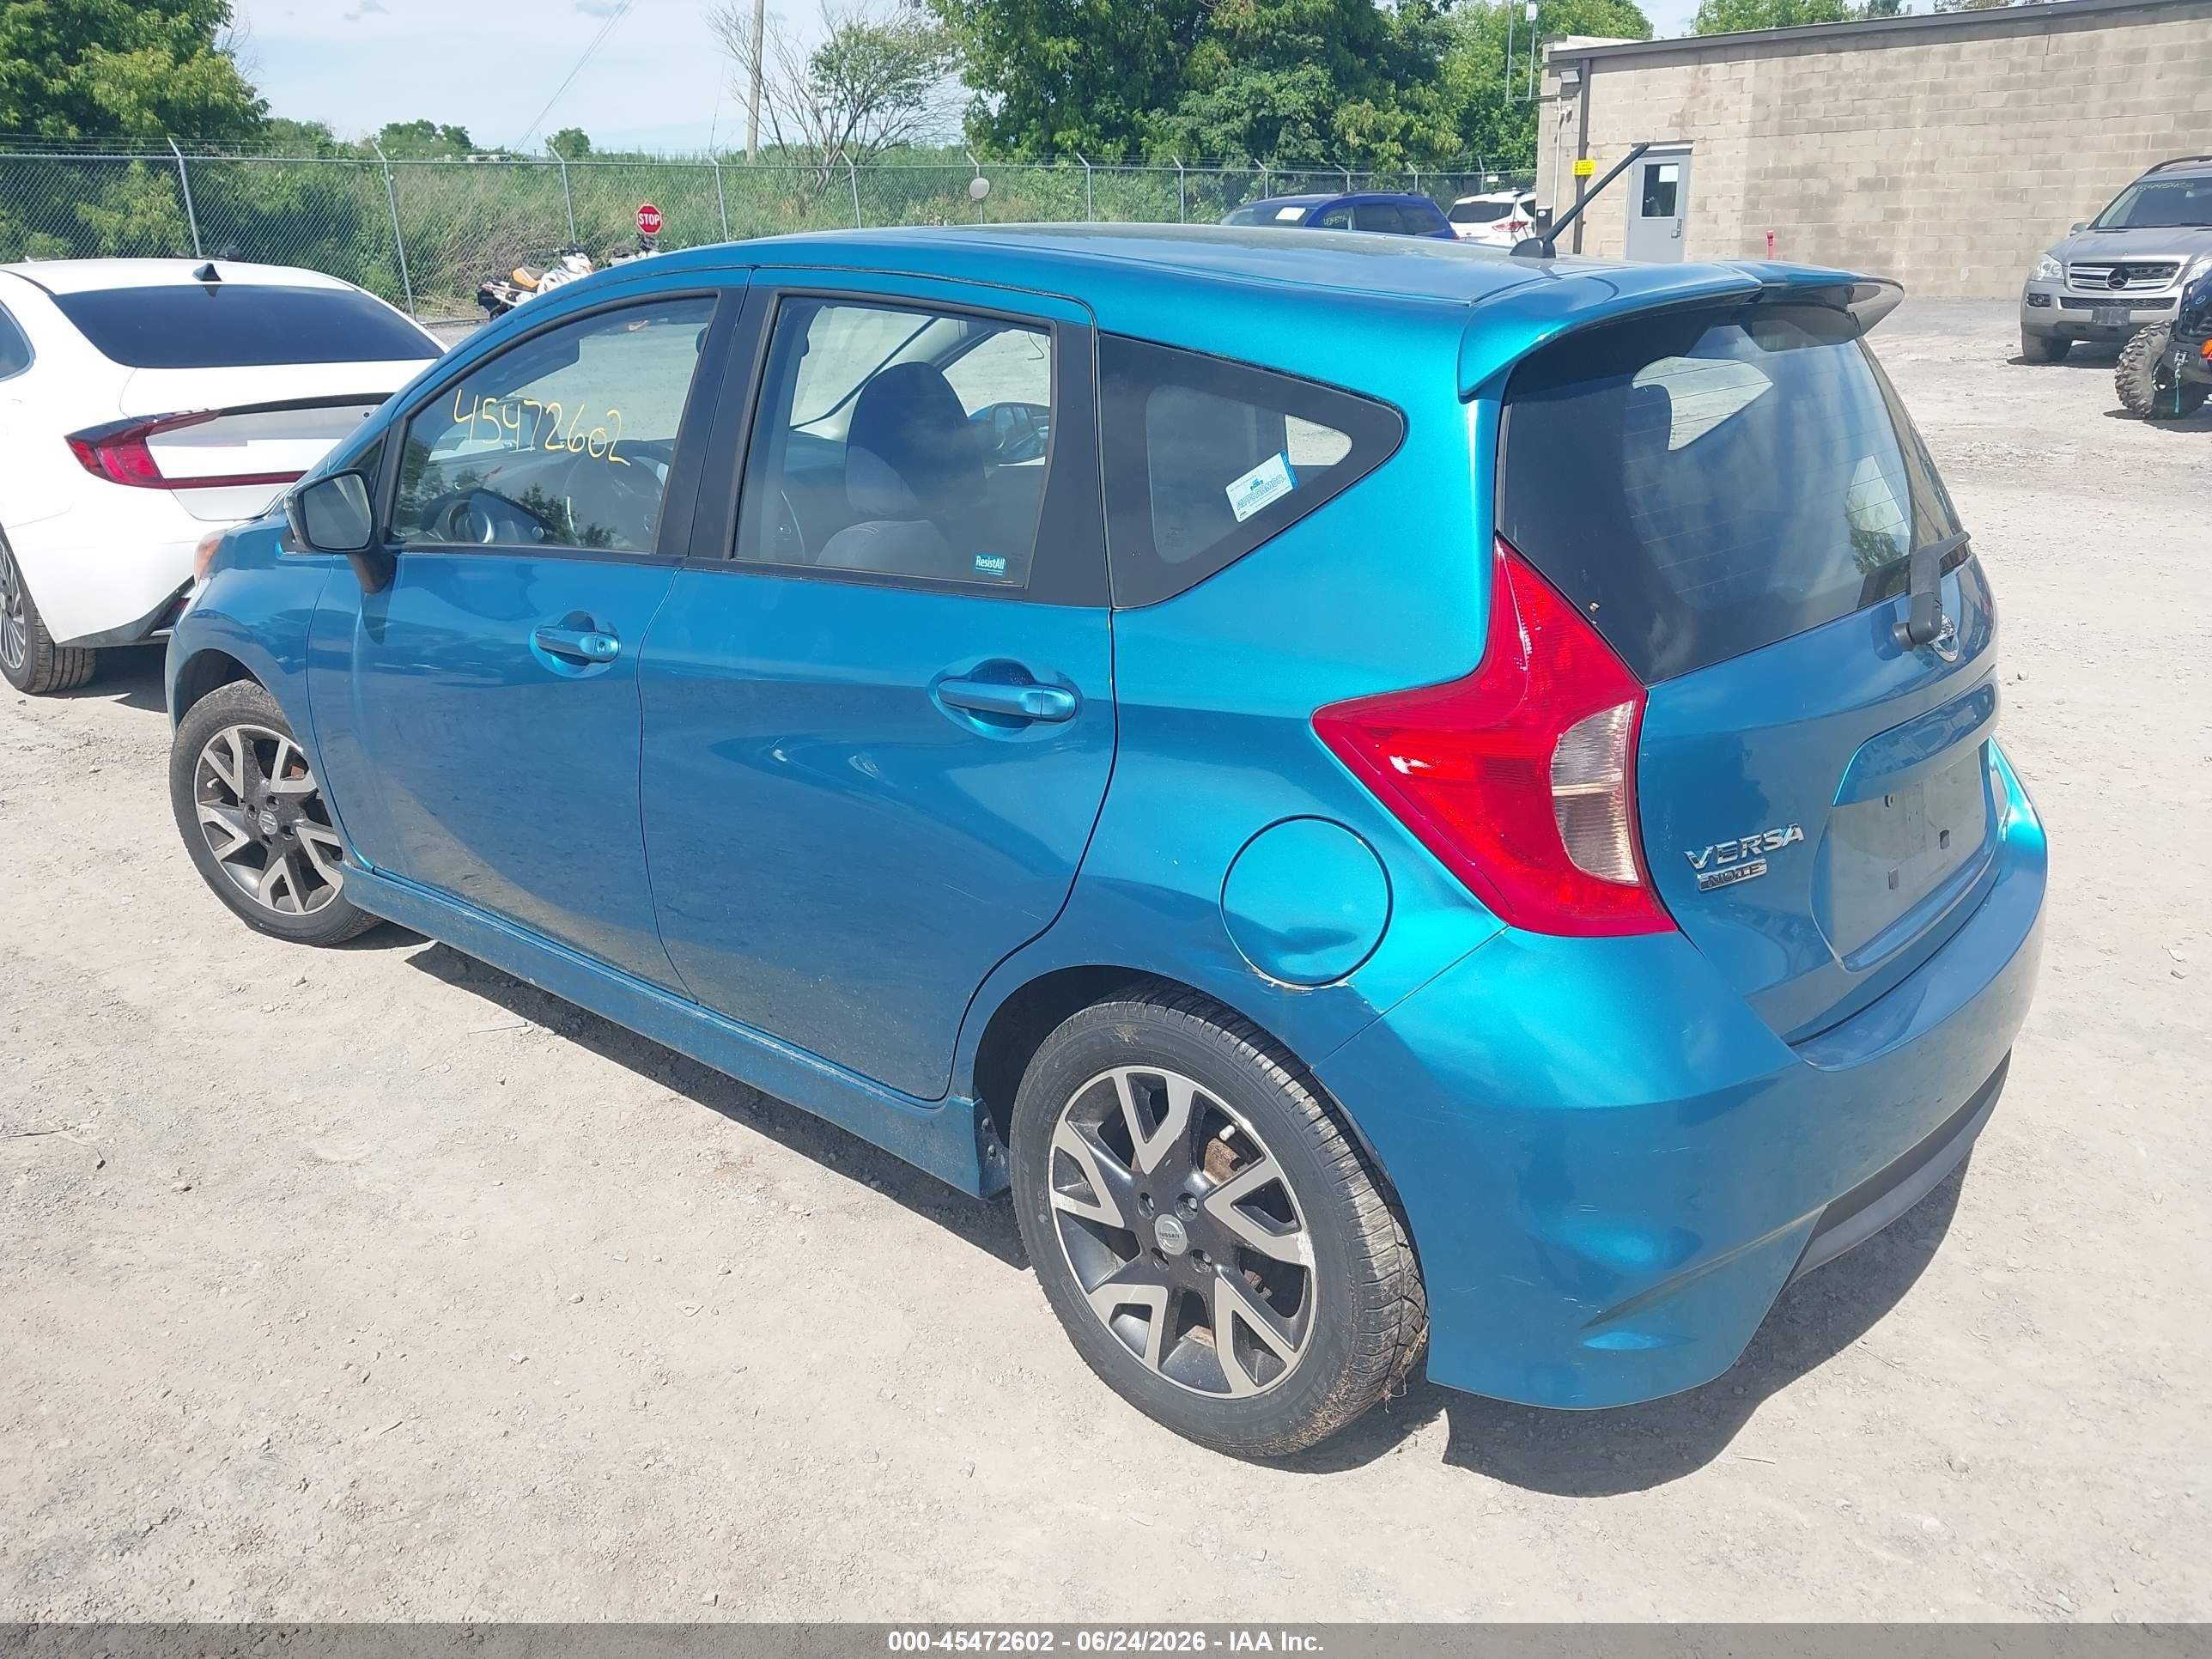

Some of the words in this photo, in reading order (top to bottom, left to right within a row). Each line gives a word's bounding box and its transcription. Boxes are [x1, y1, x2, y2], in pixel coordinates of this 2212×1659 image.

[638, 213, 660, 225] STOP
[453, 388, 631, 466] 45472602
[1236, 490, 1256, 511] AUTO
[975, 555, 1006, 569] ResistAll
[1684, 823, 1805, 870] VERSA
[1707, 862, 1763, 887] NOTE
